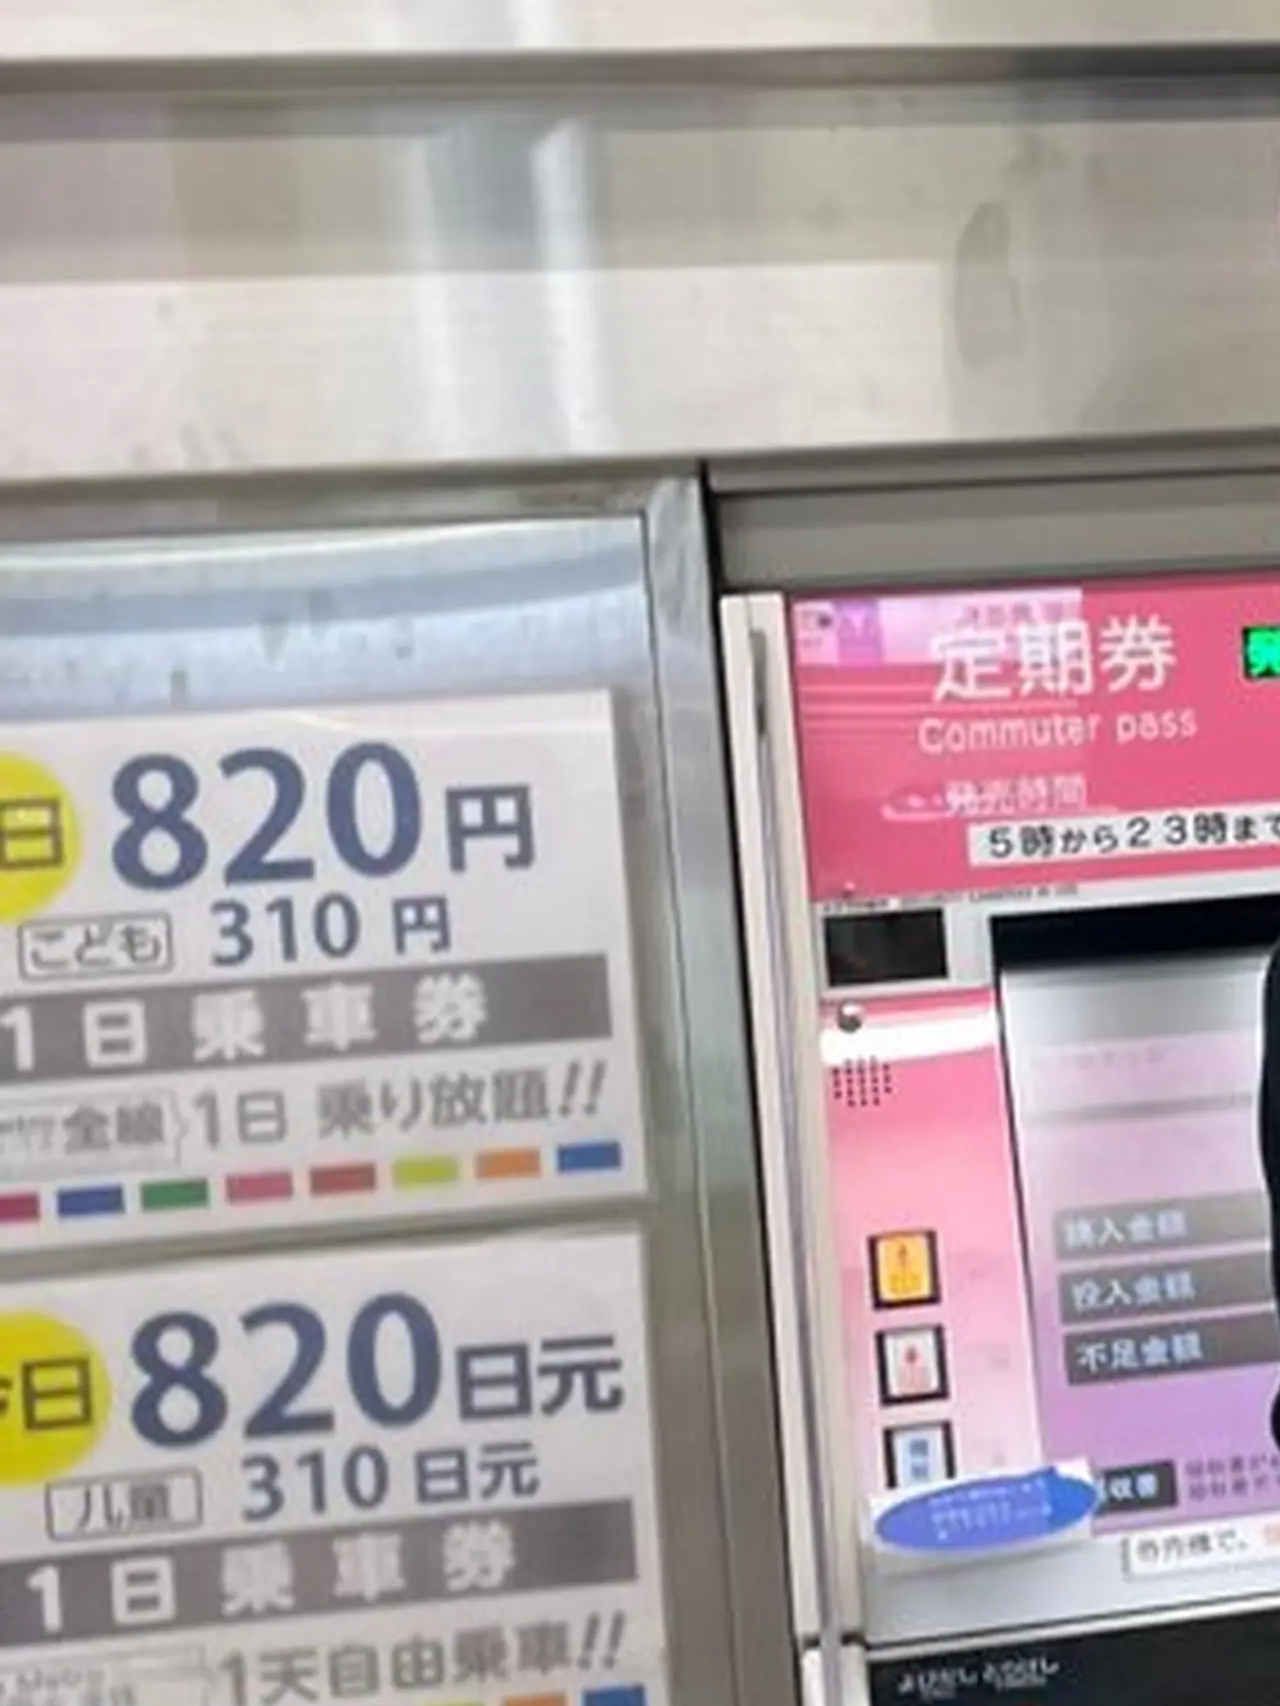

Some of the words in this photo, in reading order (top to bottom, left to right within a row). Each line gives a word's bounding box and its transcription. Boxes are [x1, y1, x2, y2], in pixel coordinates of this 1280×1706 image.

[932, 615, 1178, 701] 定期券
[918, 712, 1101, 754] Commuter
[1117, 709, 1197, 741] pass
[29, 920, 164, 970] こども
